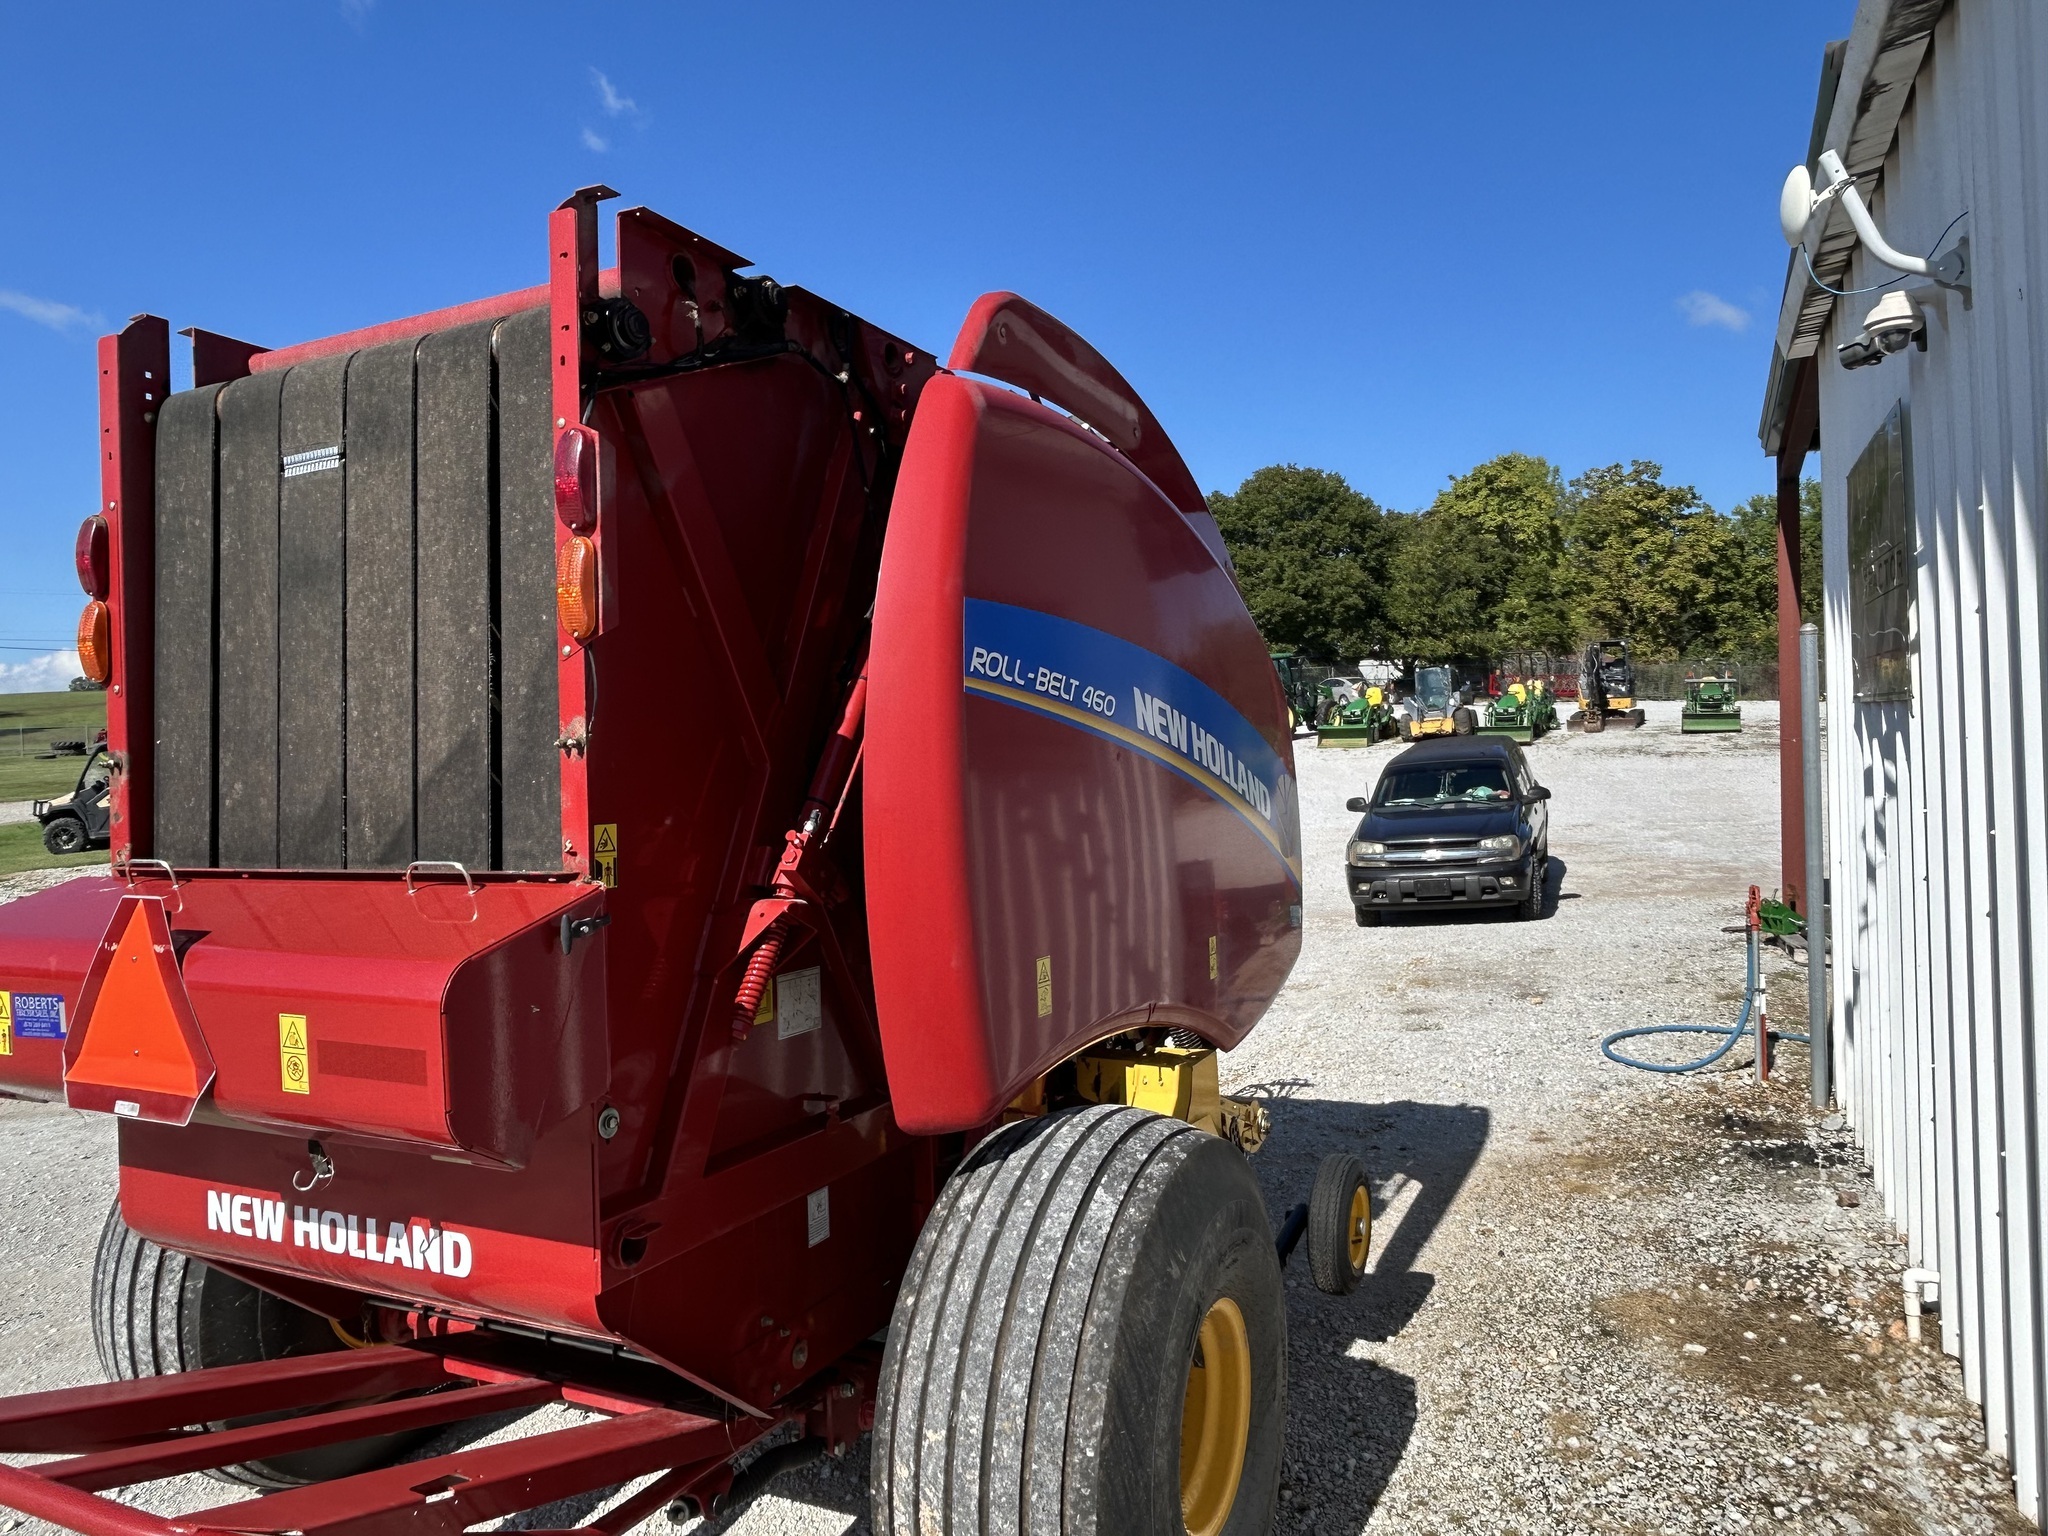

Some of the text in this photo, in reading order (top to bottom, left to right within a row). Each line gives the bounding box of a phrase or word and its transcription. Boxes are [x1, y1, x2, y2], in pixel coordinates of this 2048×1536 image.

[969, 646, 1116, 716] ROLL-BELT 460
[1133, 686, 1271, 821] NEW HOLLAND
[14, 996, 59, 1010] ROBERTS
[207, 1190, 473, 1278] NEW HOLLAND
